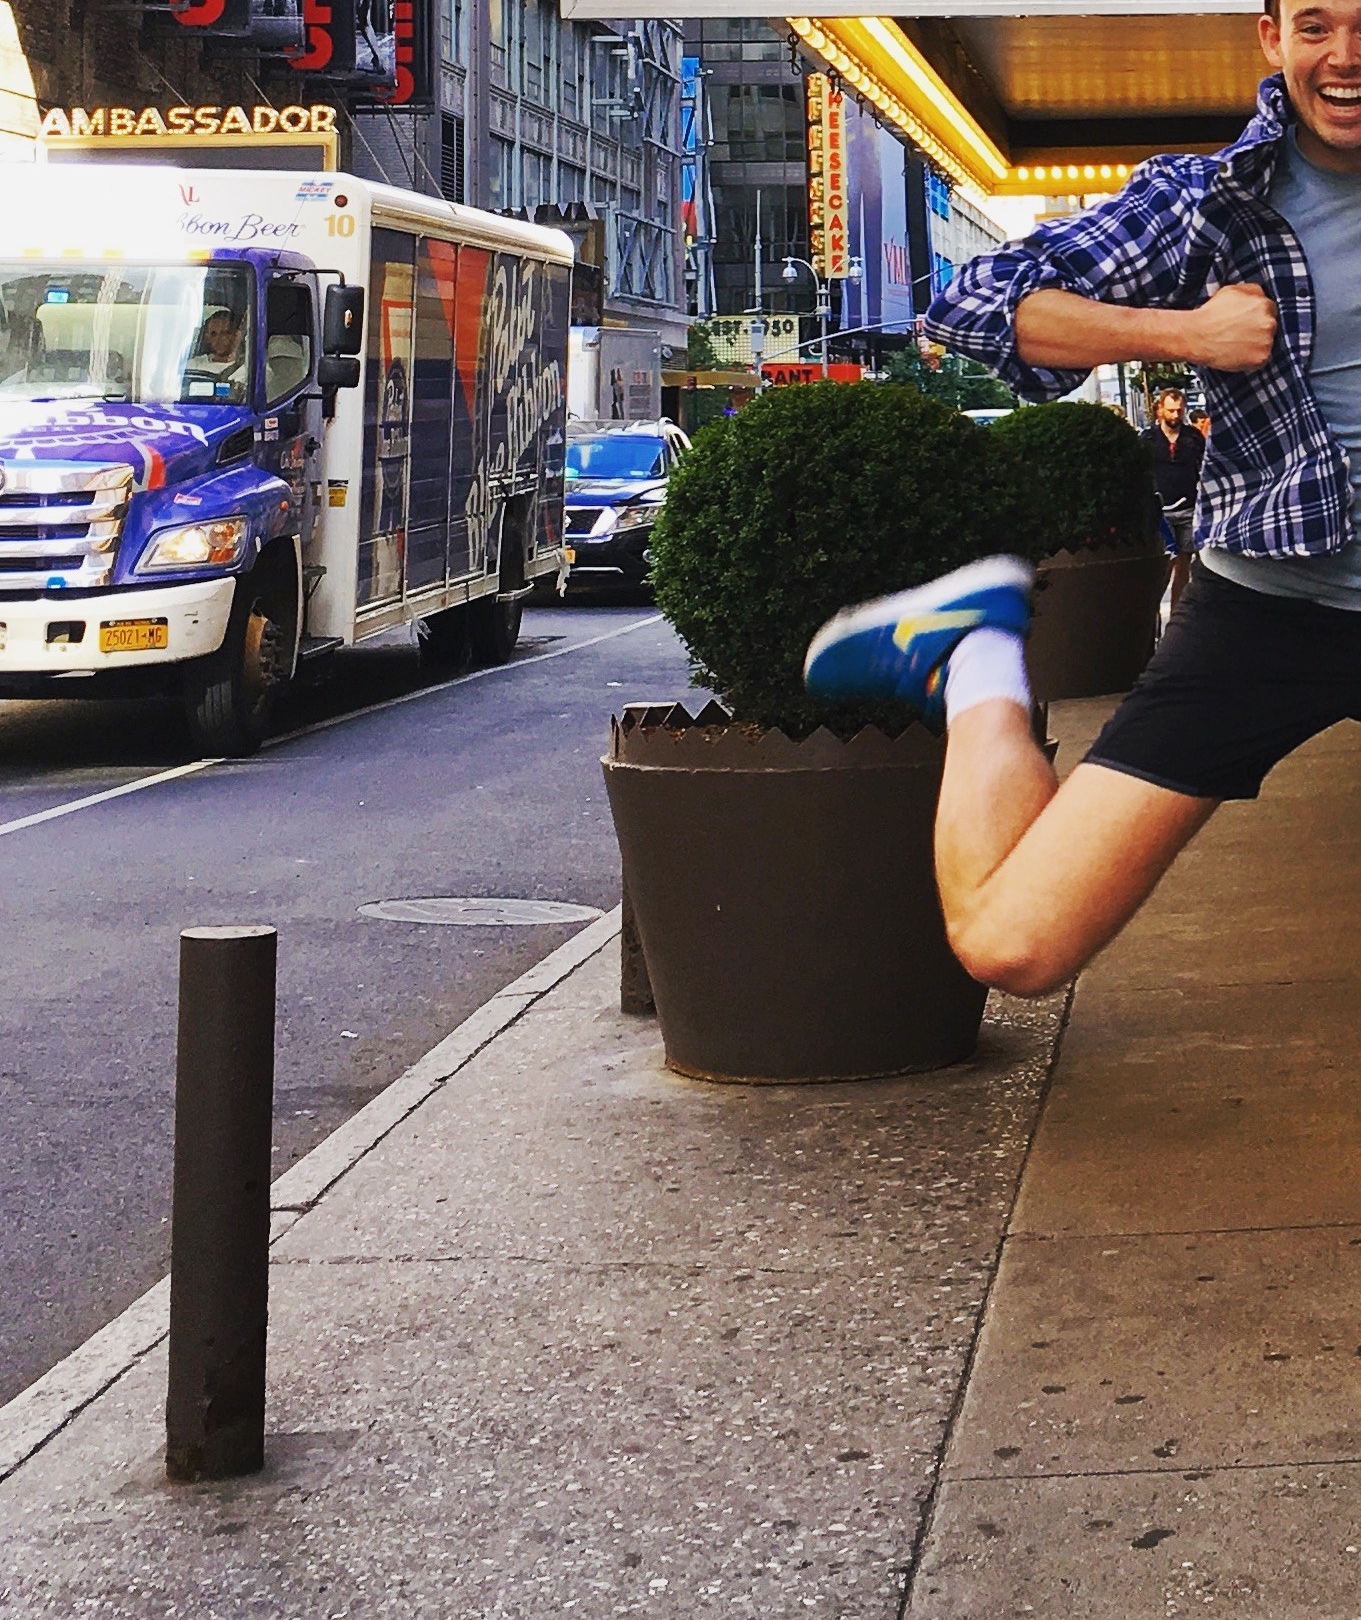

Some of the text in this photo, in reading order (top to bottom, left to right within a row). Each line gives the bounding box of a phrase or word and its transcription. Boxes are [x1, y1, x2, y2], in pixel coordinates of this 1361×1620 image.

[41, 104, 338, 134] AMBASSADOR
[224, 213, 303, 241] Beer
[324, 214, 355, 237] 10
